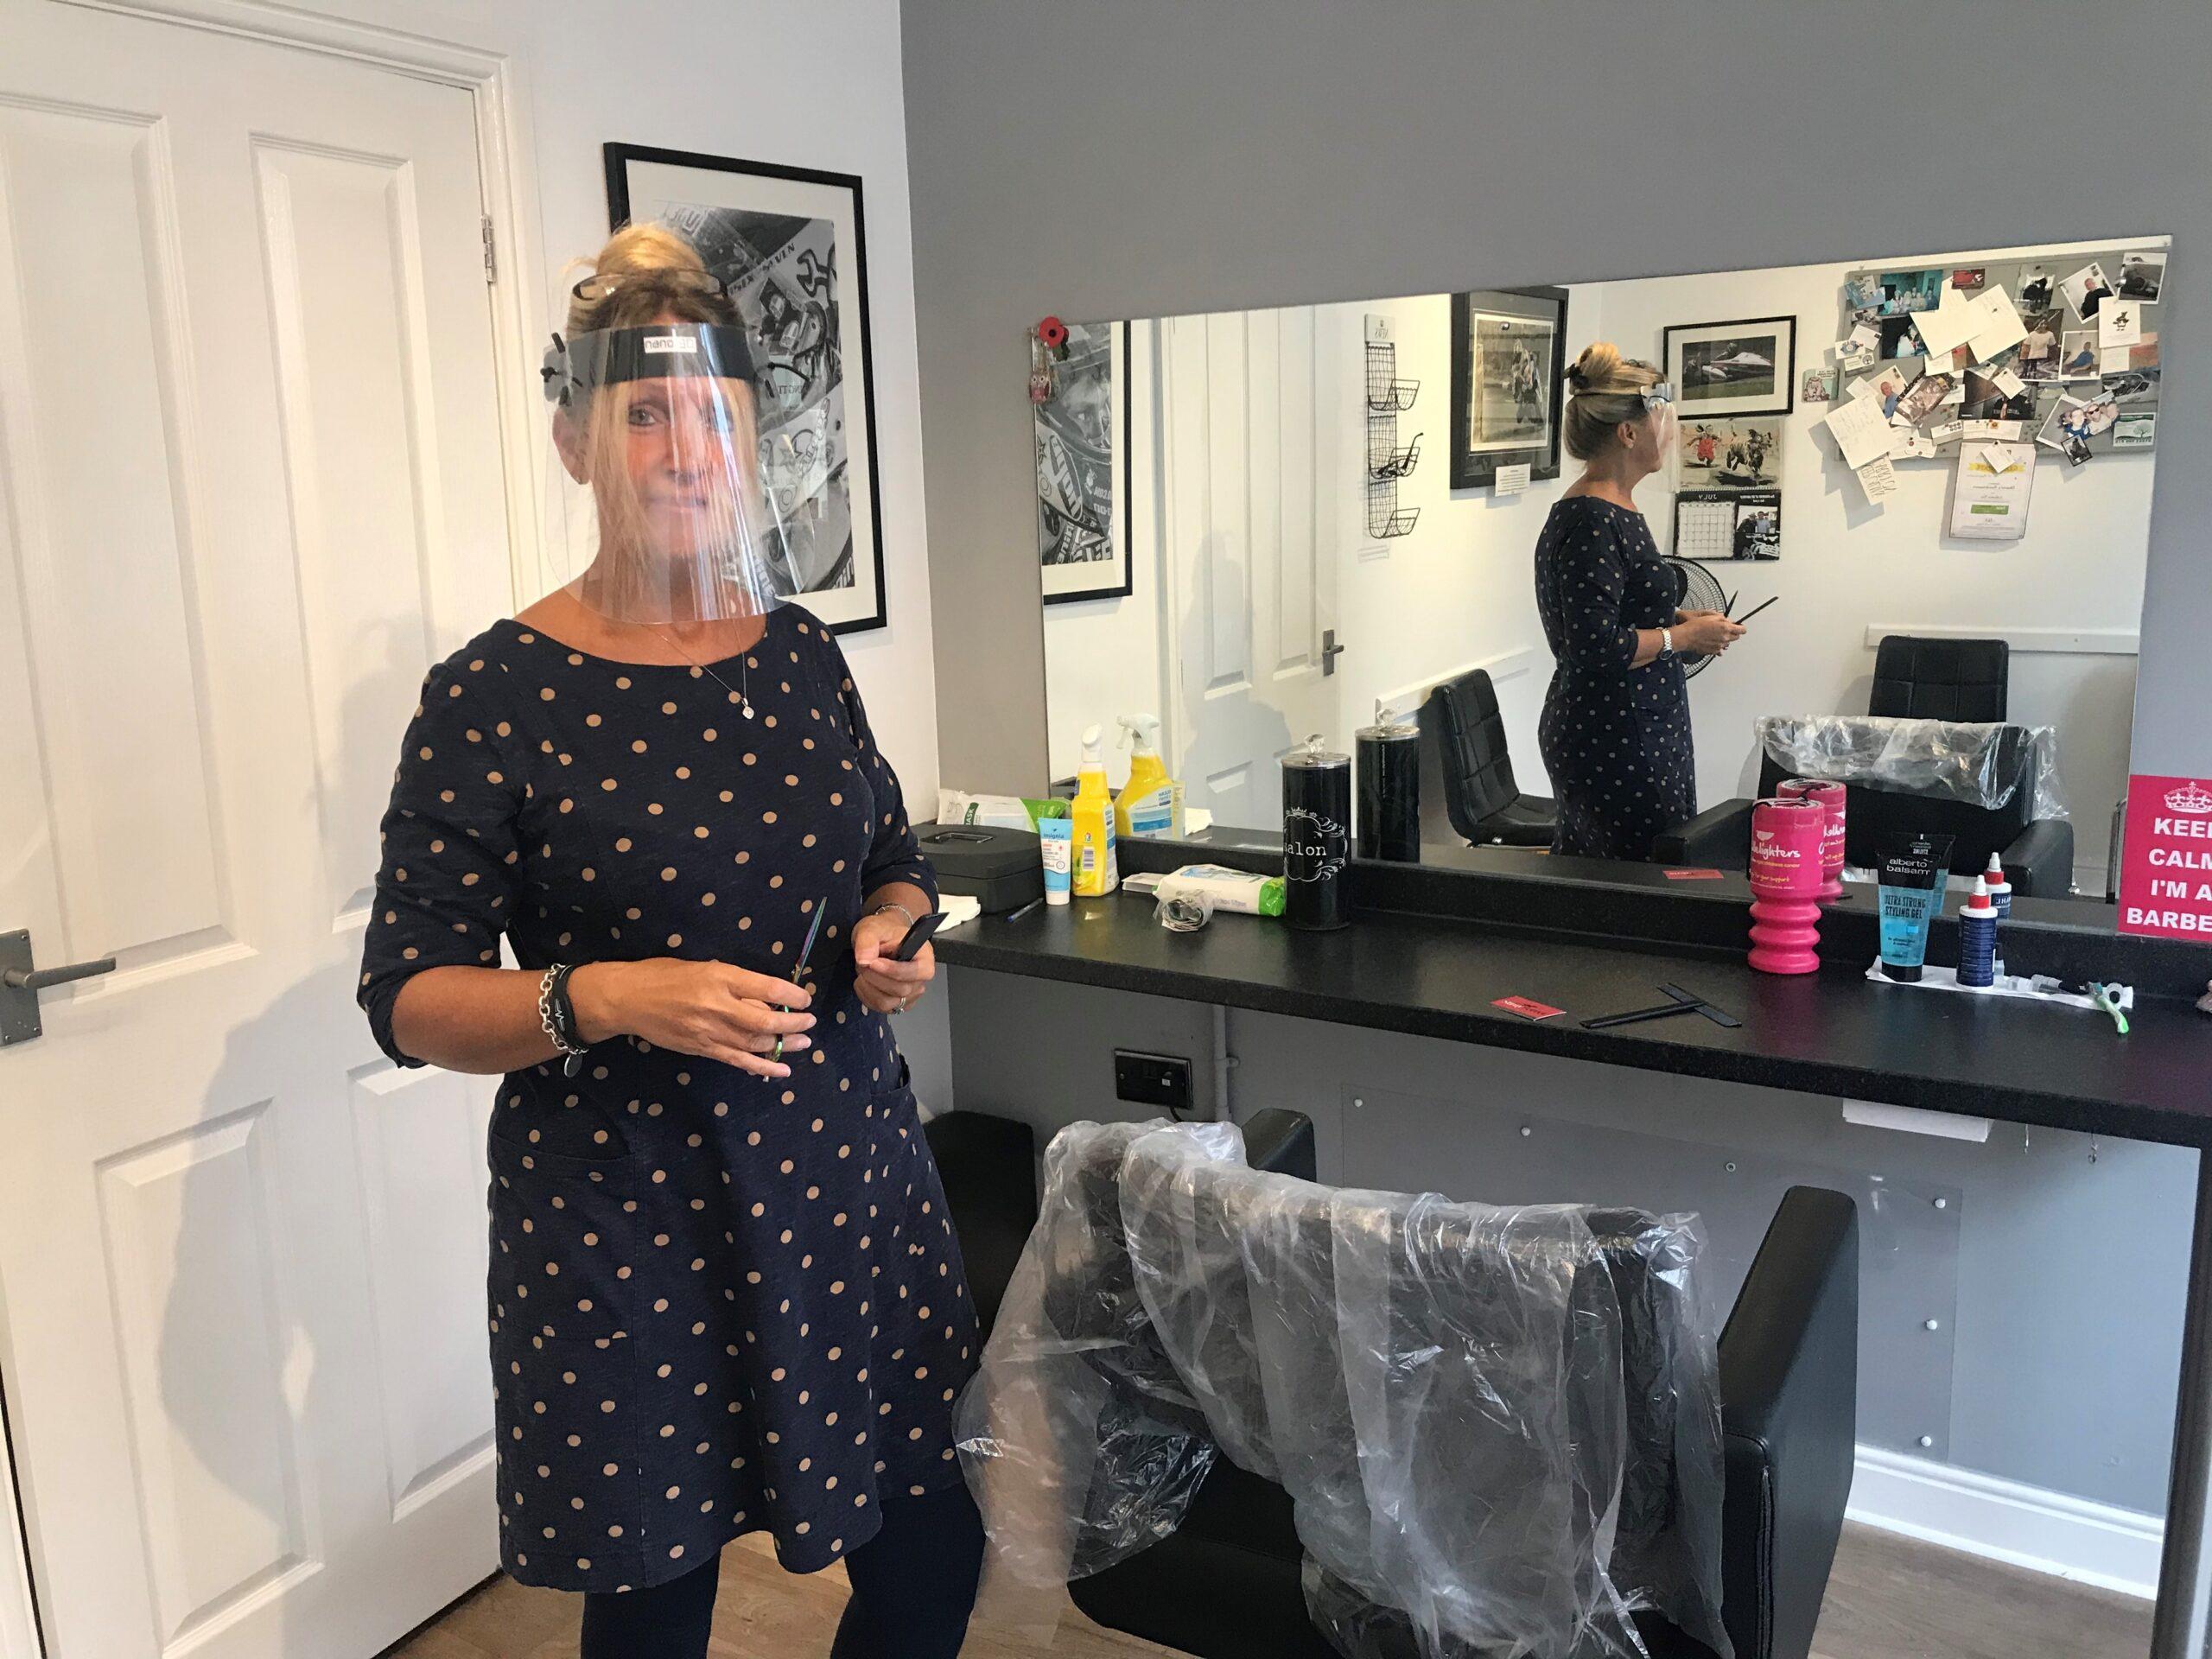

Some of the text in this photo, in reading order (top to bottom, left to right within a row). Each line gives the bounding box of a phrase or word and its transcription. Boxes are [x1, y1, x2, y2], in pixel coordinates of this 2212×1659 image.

[1886, 864, 1929, 876] balsam
[1889, 858, 1928, 868] alberto
[2151, 879, 2212, 901] I'M A
[1884, 895, 1926, 909] ULTRA STRONG
[1885, 906, 1923, 920] STYLING GEL
